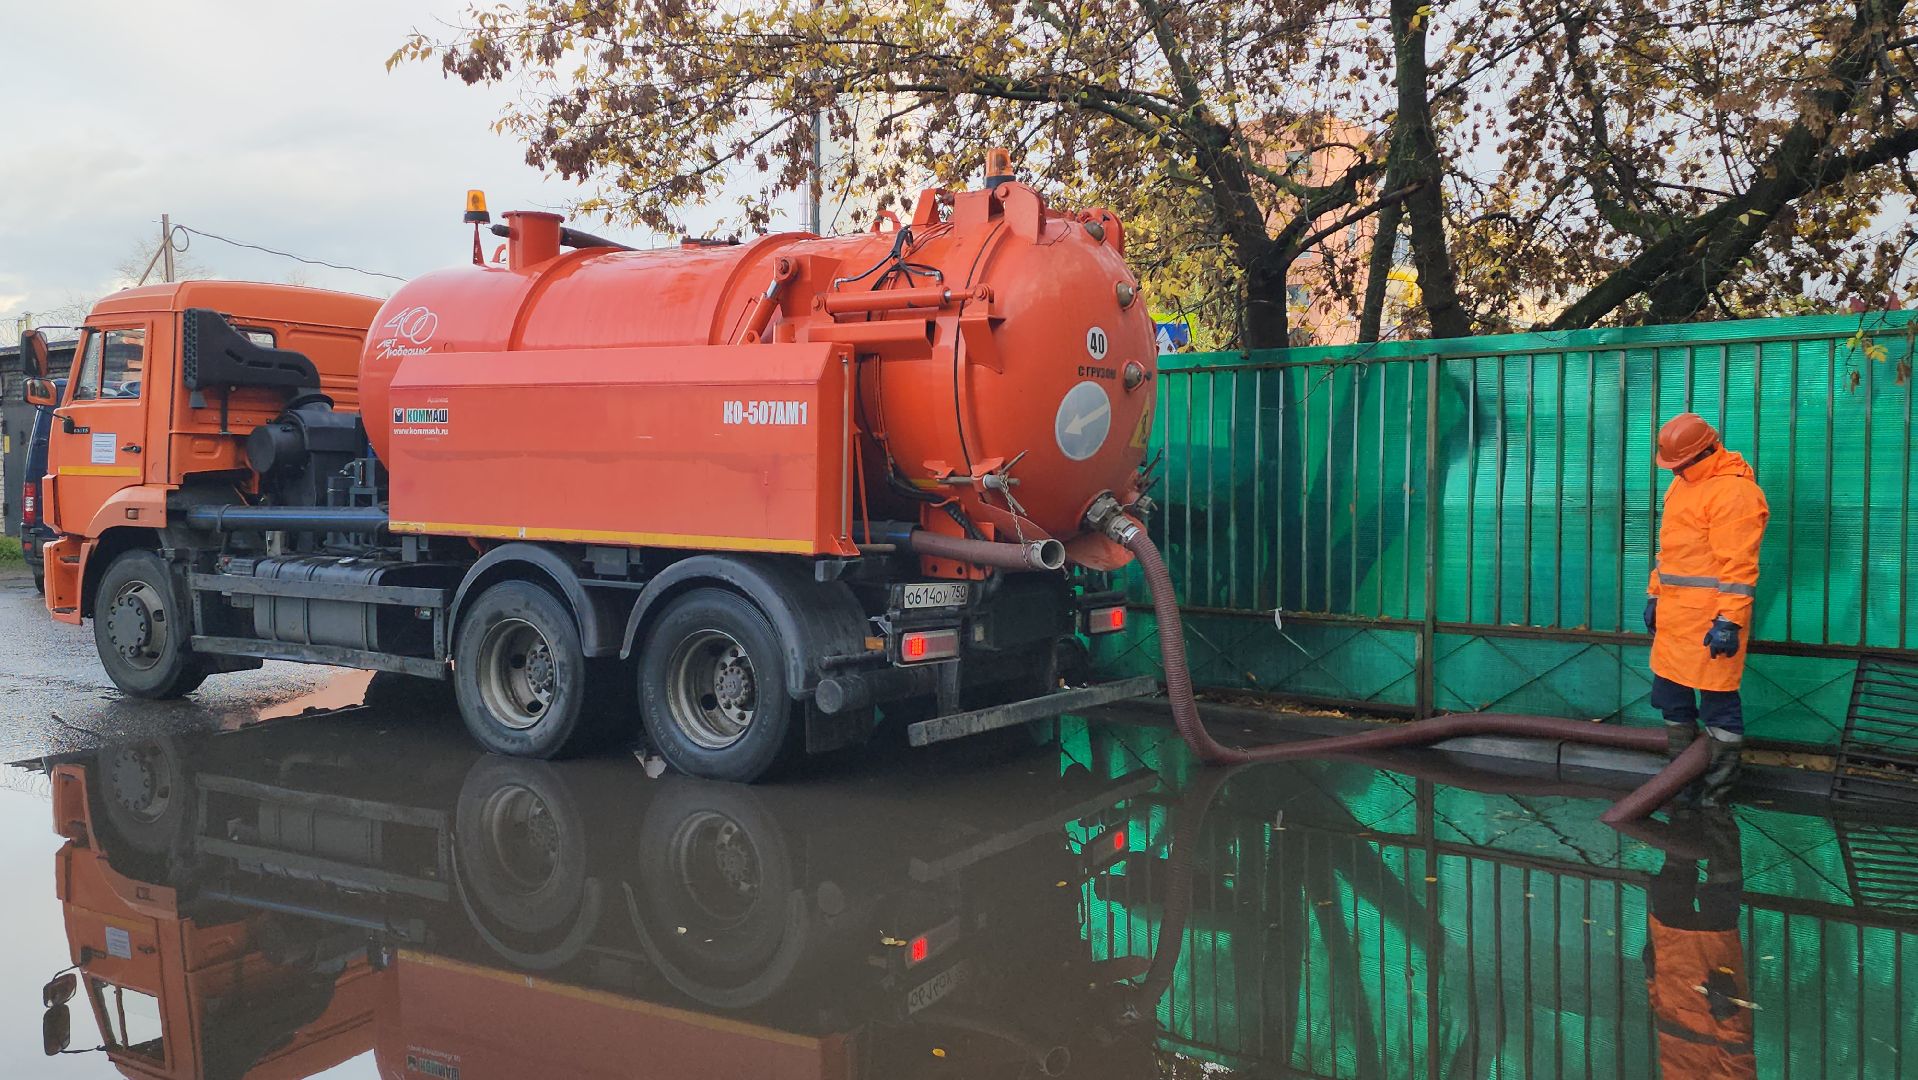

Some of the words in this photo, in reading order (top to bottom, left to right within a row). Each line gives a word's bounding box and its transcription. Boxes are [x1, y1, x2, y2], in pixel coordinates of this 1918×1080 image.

[1090, 332, 1105, 354] 40
[407, 409, 448, 423] КОММАШ
[723, 400, 807, 425] КО-507АМ1
[951, 585, 967, 598] 750
